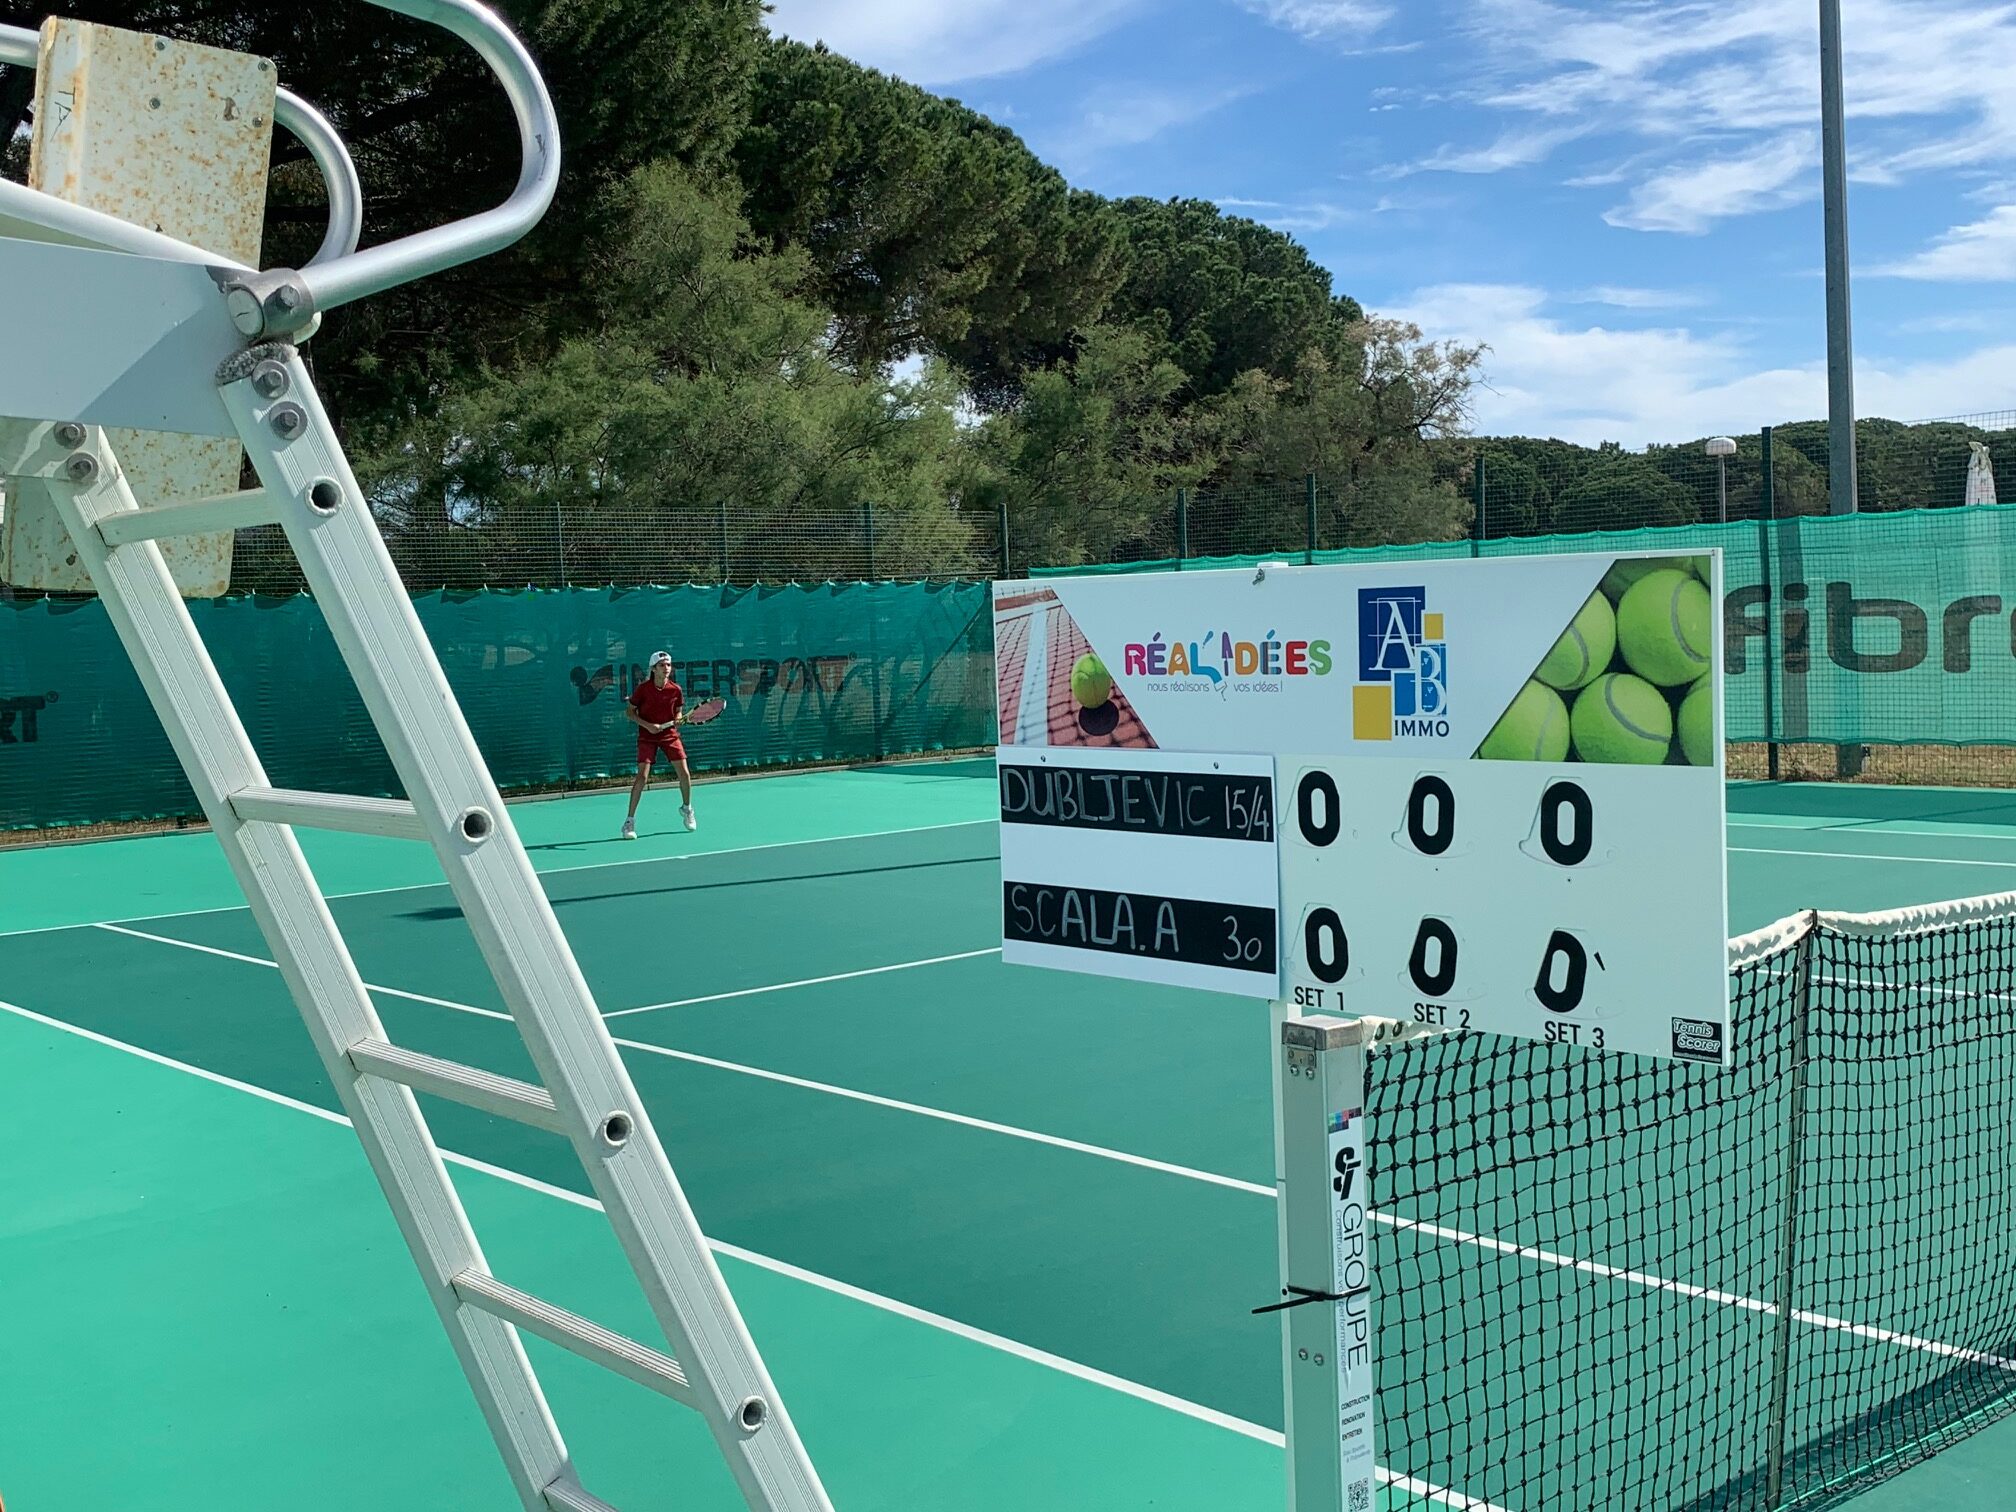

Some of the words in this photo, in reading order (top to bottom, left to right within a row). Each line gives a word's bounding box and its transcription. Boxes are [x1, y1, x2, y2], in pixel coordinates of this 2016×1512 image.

[1724, 581, 2016, 674] fibr
[1147, 682, 1168, 692] nous
[1170, 680, 1210, 692] réalisons
[1233, 682, 1250, 692] vos
[1394, 719, 1450, 737] IMMO
[1001, 768, 1211, 828] DUBLJEVIC
[1225, 784, 1270, 840] 15/4
[1298, 770, 1341, 847] 0
[1408, 775, 1455, 855] 0
[1540, 781, 1593, 866] 0
[1305, 907, 1349, 983] 0
[1408, 917, 1458, 997] 0
[1534, 930, 1587, 1013] 0
[1294, 986, 1325, 1008] SET
[1336, 991, 1344, 1011] 1
[1413, 1002, 1448, 1026] SET
[1459, 1008, 1471, 1029] 2
[1673, 1020, 1713, 1037] Tennis
[1544, 1020, 1581, 1044] SET
[1592, 1027, 1605, 1048] 3
[1678, 1034, 1720, 1052] Scorer
[1335, 1209, 1344, 1277] Construisons
[1343, 1202, 1368, 1371] GROUPE
